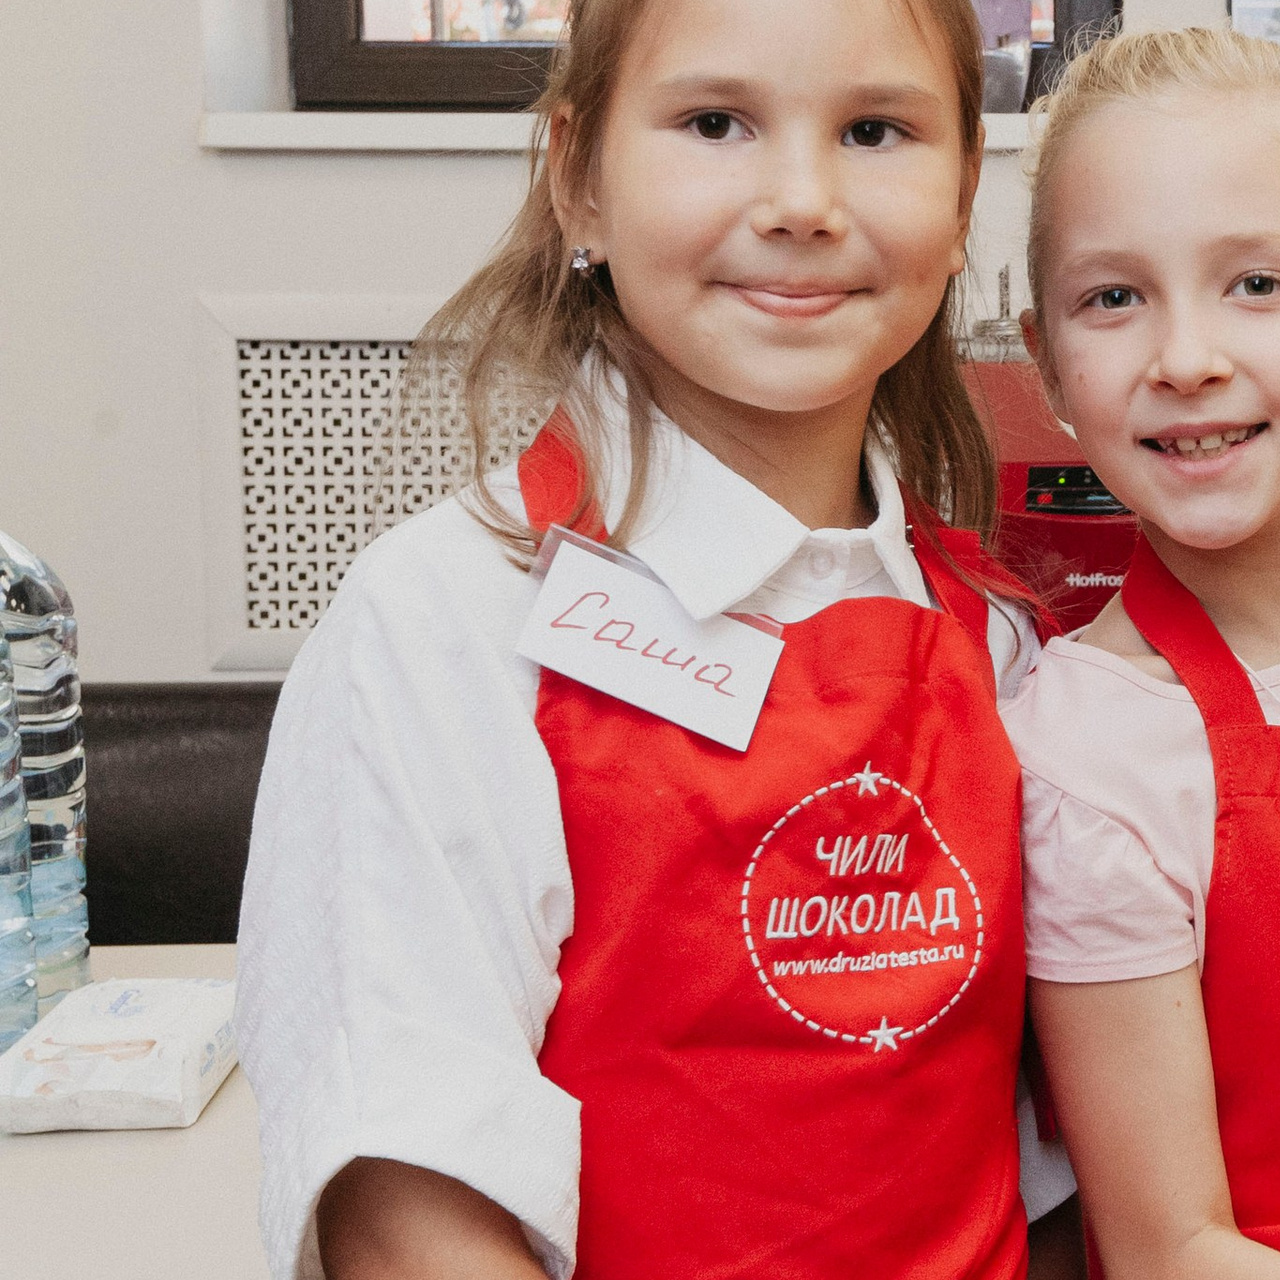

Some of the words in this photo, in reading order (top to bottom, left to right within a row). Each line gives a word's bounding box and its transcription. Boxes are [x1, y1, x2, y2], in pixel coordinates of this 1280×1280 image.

[1065, 572, 1125, 587] HotFros
[550, 591, 736, 698] Саша
[815, 833, 909, 876] ЧИЛИ
[765, 887, 960, 939] ШОКОЛАД
[773, 943, 965, 976] www.druziatesta.ru
